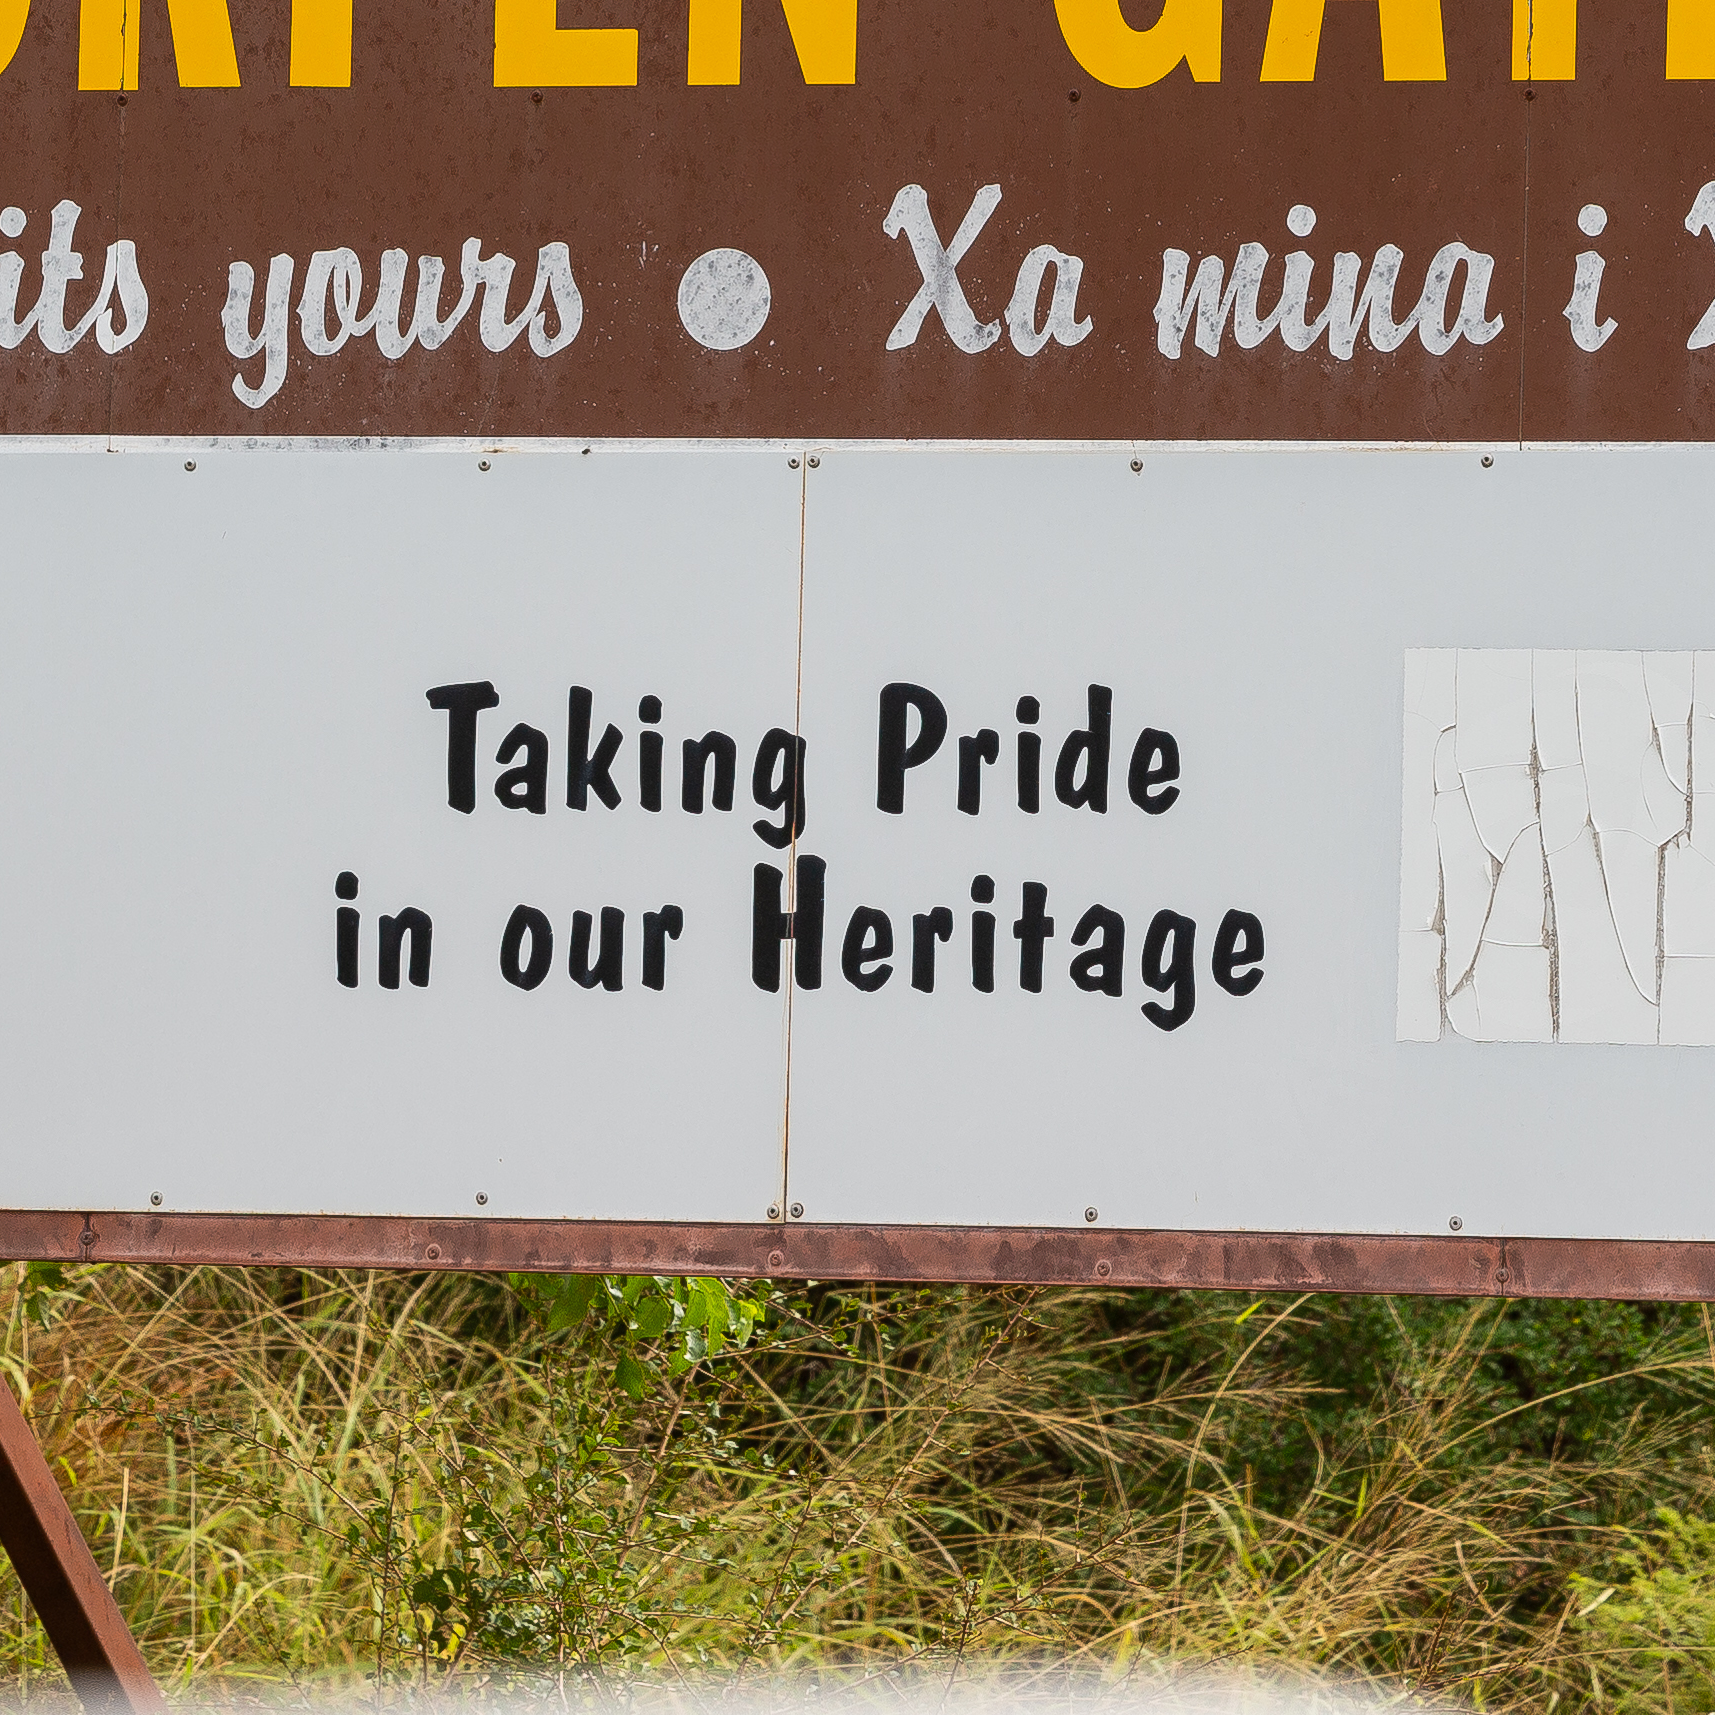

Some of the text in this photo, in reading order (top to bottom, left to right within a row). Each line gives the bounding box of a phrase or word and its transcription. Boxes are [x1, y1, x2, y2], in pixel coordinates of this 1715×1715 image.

[220, 236, 584, 410] yours
[882, 183, 1094, 357] Xa
[1152, 203, 1505, 361] mina
[1561, 203, 1619, 353] i
[425, 680, 1181, 850] Taking Pride
[335, 854, 1265, 1032] in our Heritage
